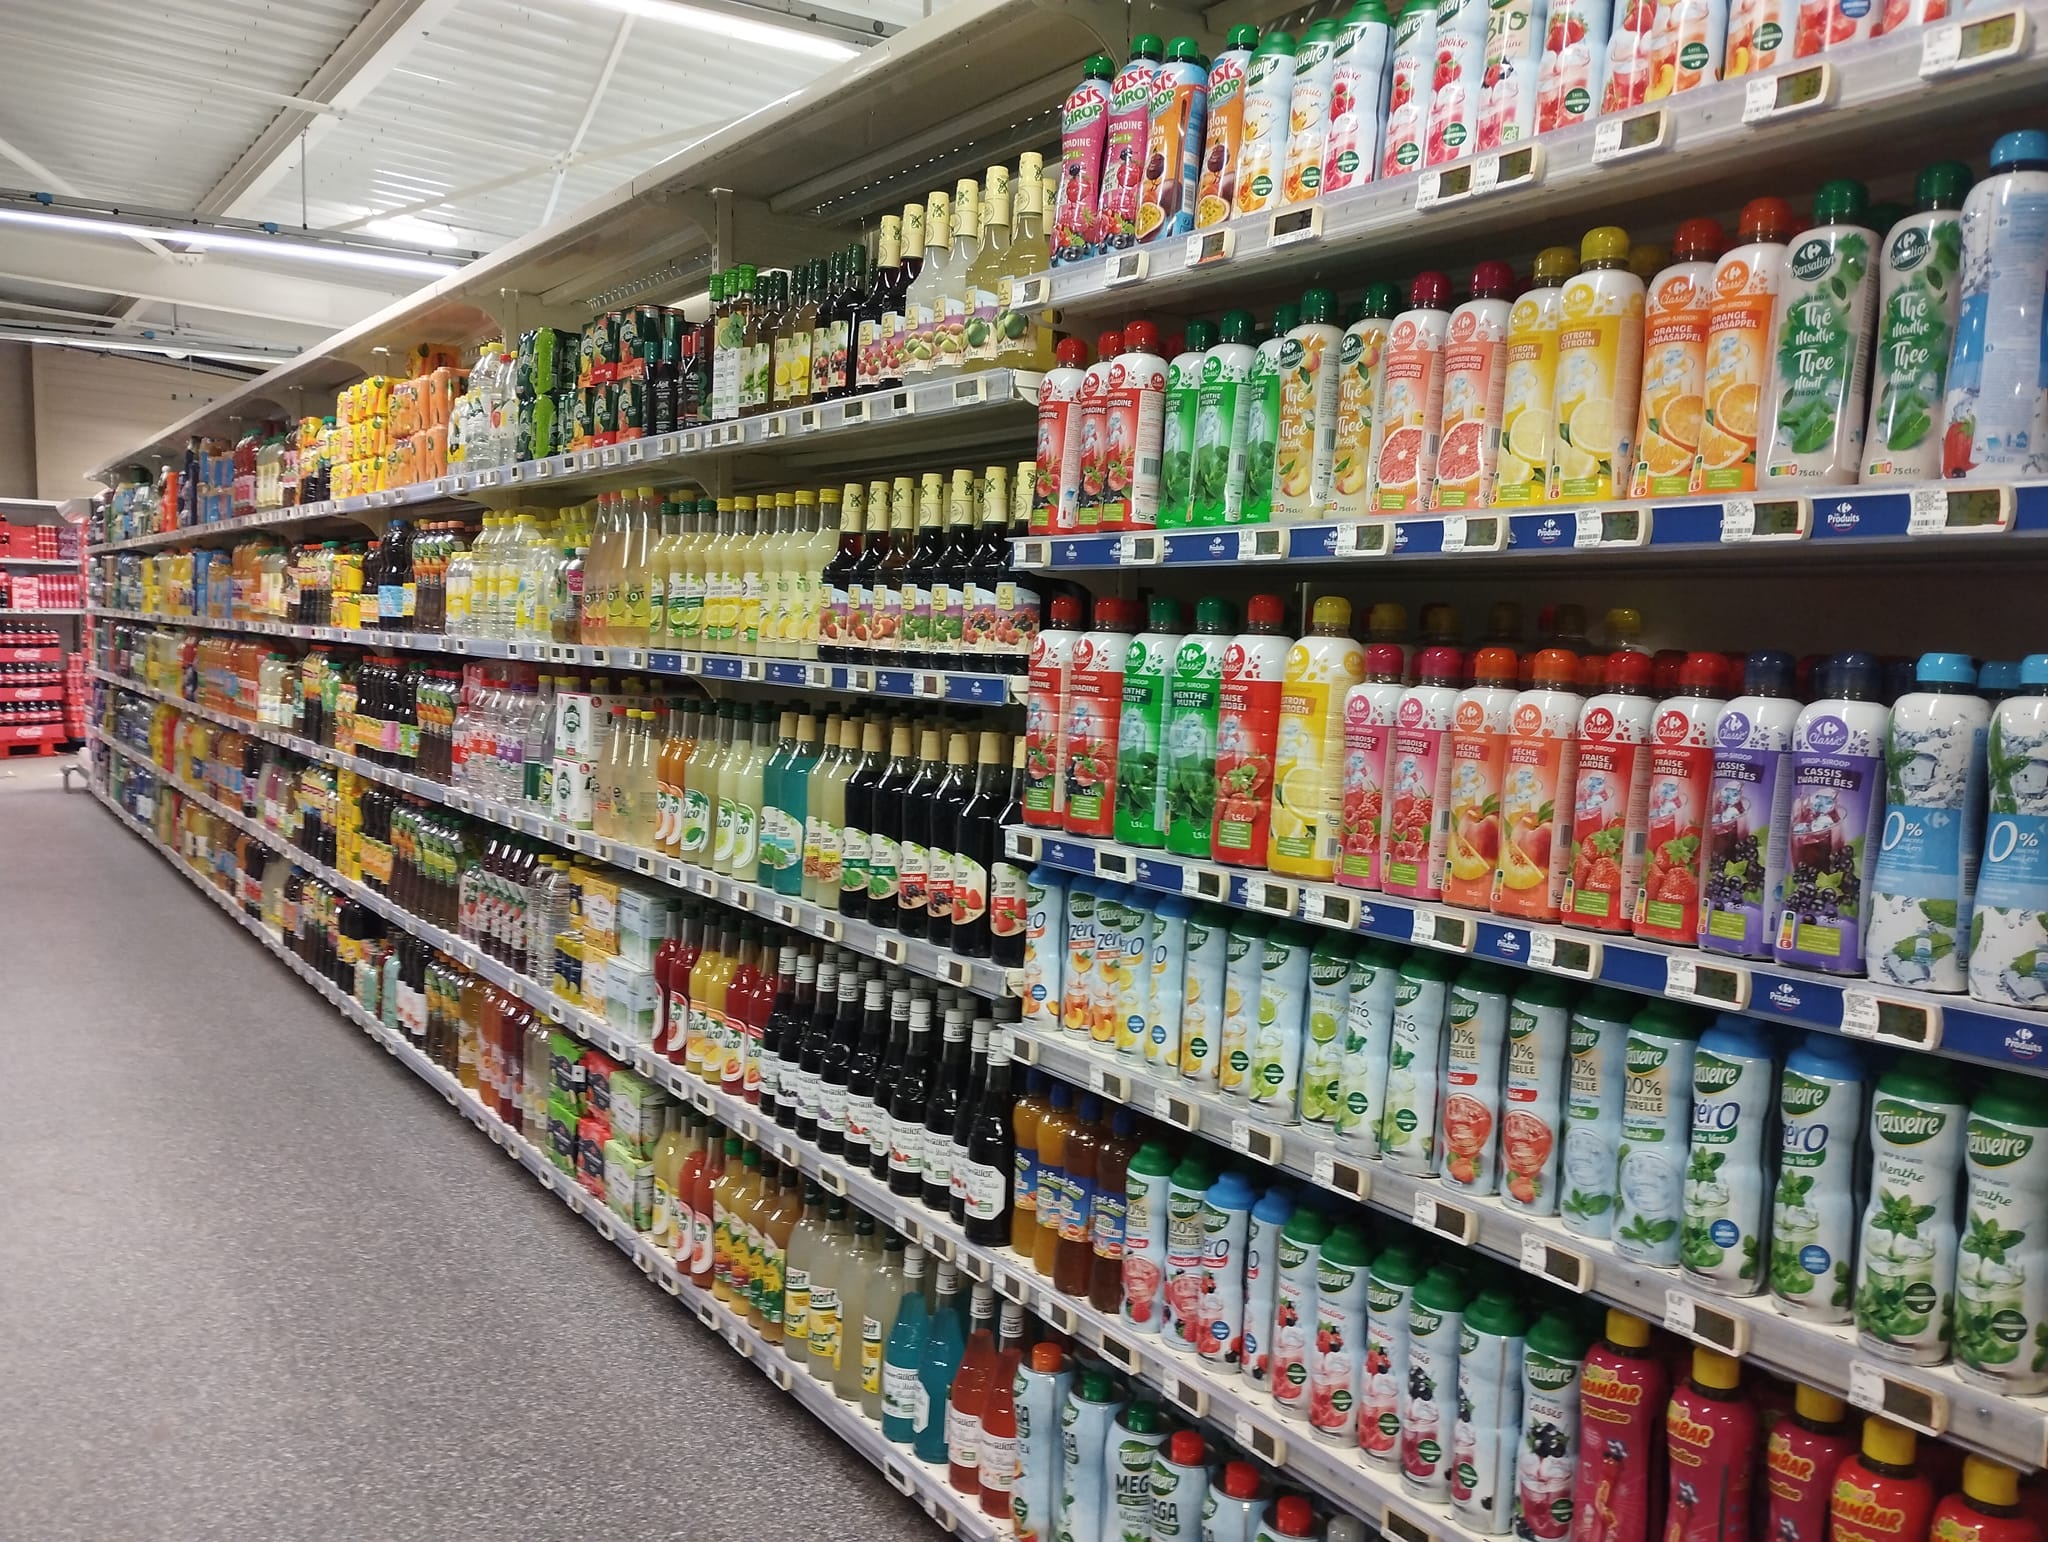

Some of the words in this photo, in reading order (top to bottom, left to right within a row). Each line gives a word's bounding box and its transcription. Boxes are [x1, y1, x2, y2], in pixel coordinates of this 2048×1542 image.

[1111, 66, 1153, 95] asis
[1065, 86, 1105, 112] asis
[1791, 254, 1836, 278] Sensation
[1895, 292, 1929, 320] Thé
[1711, 310, 1748, 325] ORANGE
[1797, 301, 1834, 330] Thé
[1562, 330, 1592, 342] CITRON
[1653, 325, 1693, 336] ORANGE
[1890, 341, 1930, 370] Thee
[1792, 349, 1836, 377] Thee
[1827, 513, 1860, 525] Produits
[1173, 692, 1207, 701] MENTHE
[1220, 693, 1242, 702] RAISE
[1176, 700, 1202, 708] MUNT
[1585, 722, 1612, 735] Classic
[1658, 726, 1686, 739] Classic
[1719, 728, 1747, 742] Classic
[1808, 733, 1846, 747] Classic
[1581, 753, 1610, 763] FRAISE
[1654, 759, 1683, 769] FRAISE
[1716, 761, 1746, 772] CASSIS
[1804, 767, 1842, 778] CASSIS
[1738, 771, 1757, 782] BES
[1797, 776, 1832, 786] ZWARTE
[1833, 777, 1854, 789] BES
[1769, 991, 1801, 1005] Produits
[2005, 1037, 2044, 1053] Produits
[1626, 1076, 1663, 1096] 00%
[1875, 1110, 1940, 1136] Teisseire
[1966, 1131, 2027, 1158] Teisseire
[1879, 1160, 1926, 1183] Menthe
[1887, 1176, 1911, 1188] verte
[1526, 1361, 1572, 1383] Teisseire
[1529, 1397, 1563, 1419] Cassis
[1116, 1474, 1150, 1495] MEG
[1151, 1498, 1179, 1523] EGA
